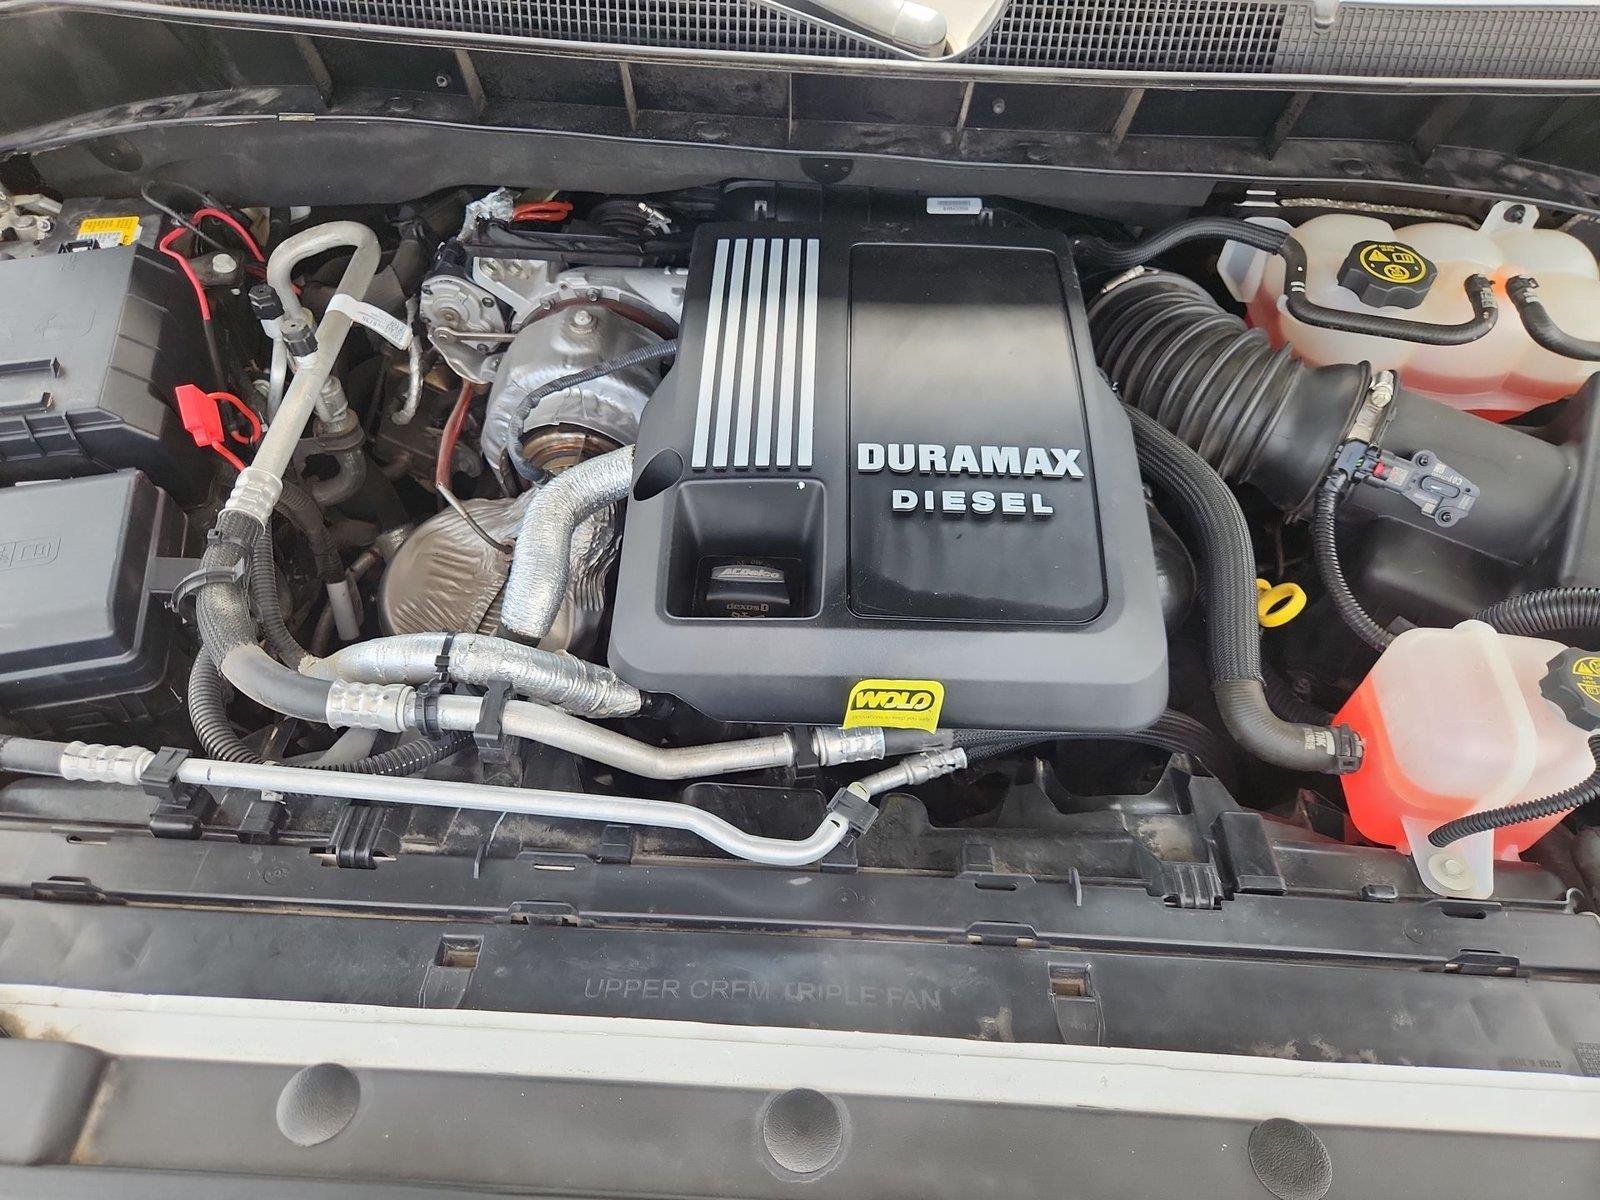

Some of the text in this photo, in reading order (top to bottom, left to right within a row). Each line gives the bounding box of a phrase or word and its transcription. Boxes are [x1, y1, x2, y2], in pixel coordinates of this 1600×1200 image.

[857, 443, 1084, 479] DURAMAX
[892, 489, 1054, 516] DIESEL
[719, 567, 780, 579] ACDelco
[855, 690, 932, 710] WOLO
[584, 978, 680, 999] UPPER
[690, 979, 770, 1001] CRFM
[886, 986, 943, 1012] FAN
